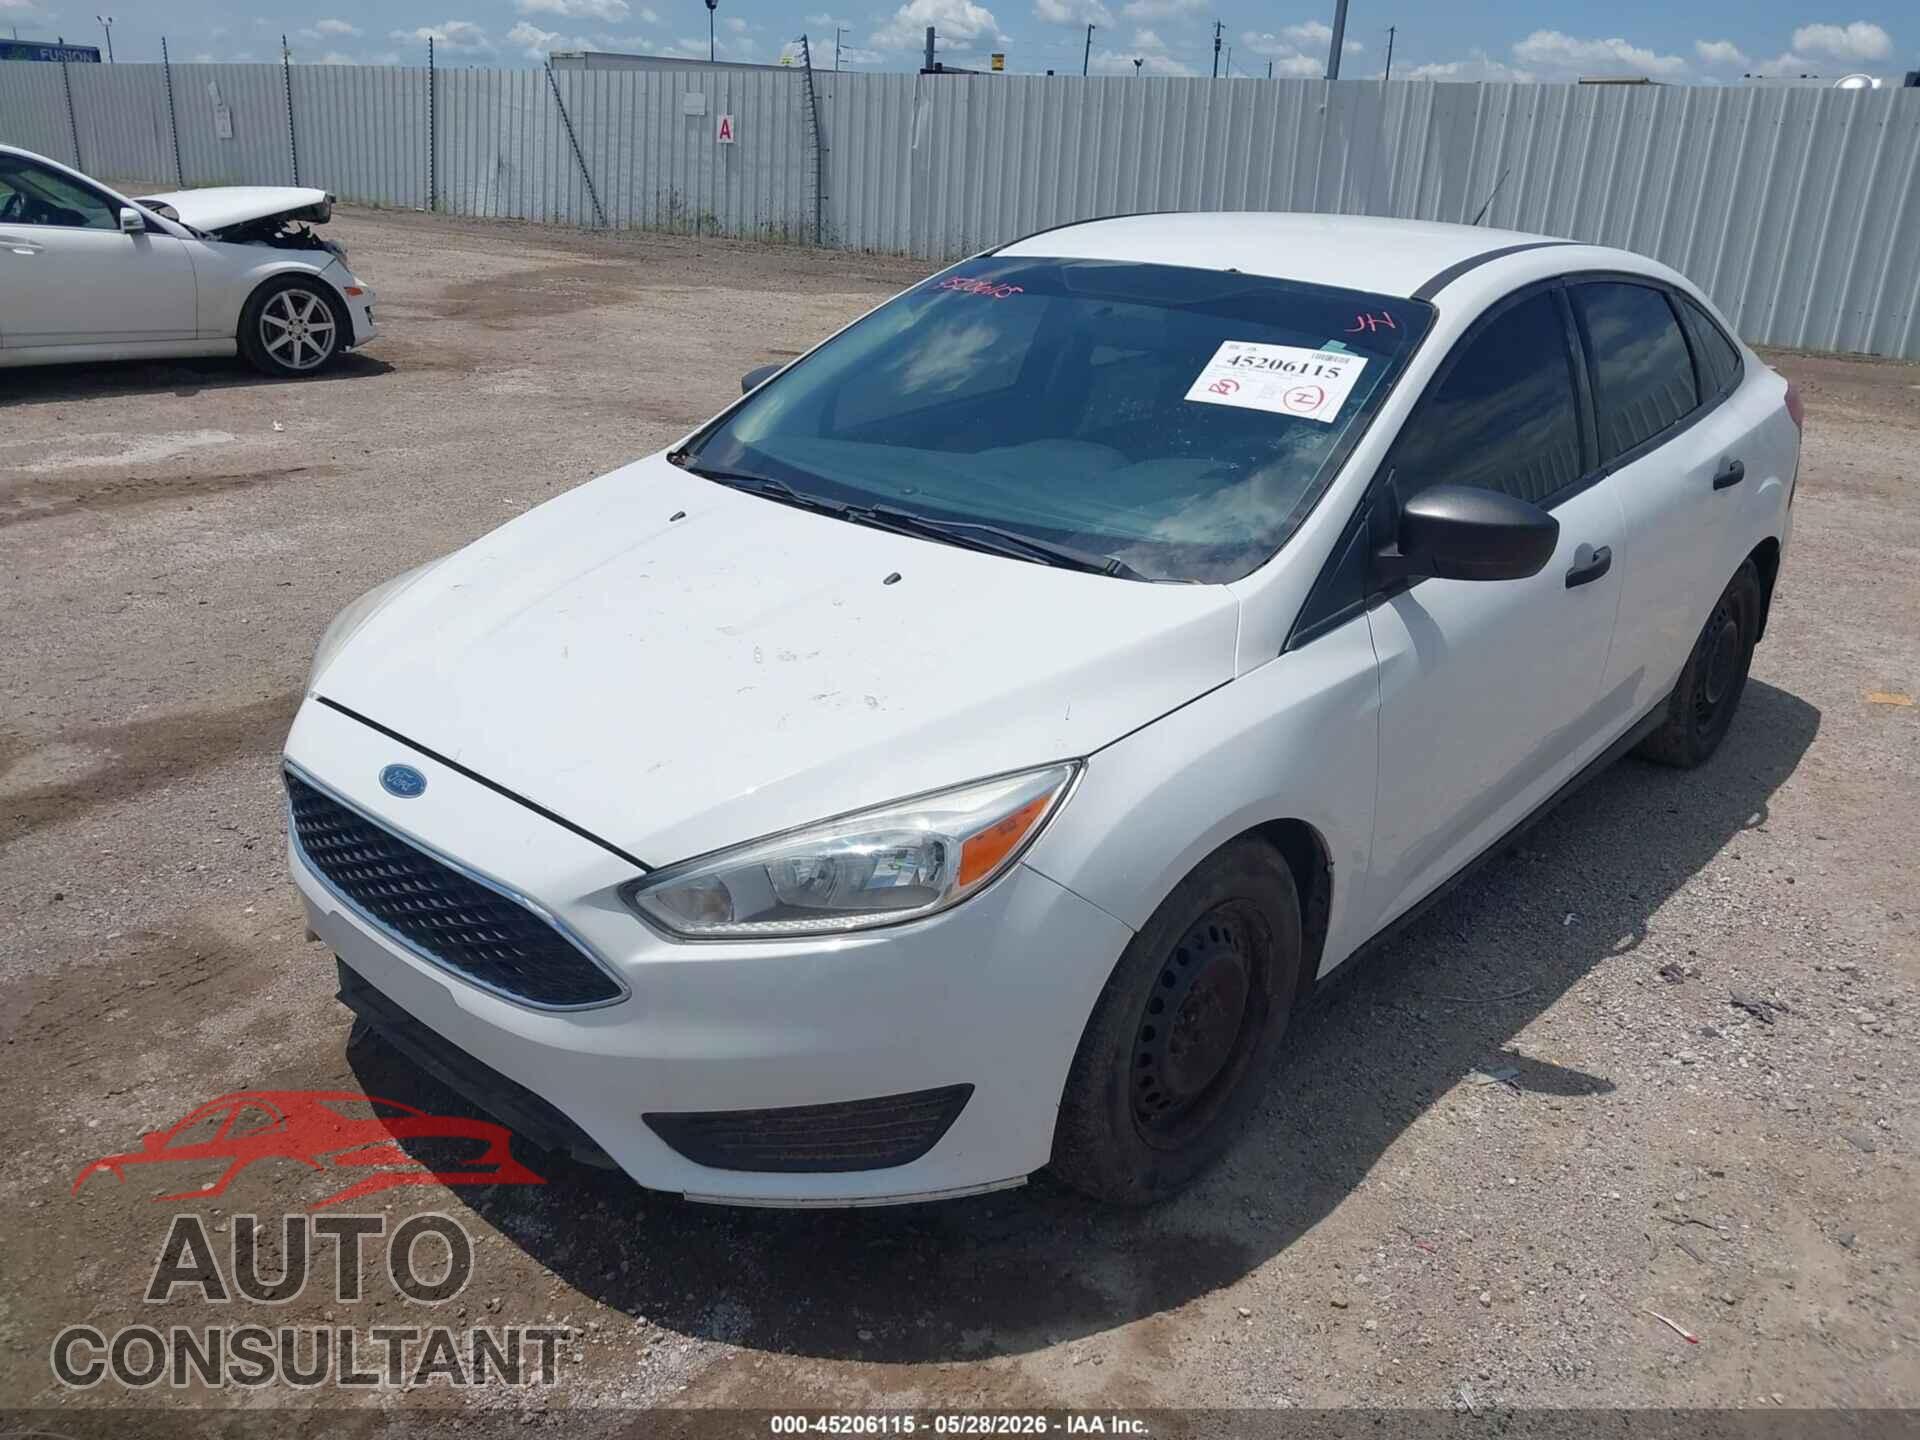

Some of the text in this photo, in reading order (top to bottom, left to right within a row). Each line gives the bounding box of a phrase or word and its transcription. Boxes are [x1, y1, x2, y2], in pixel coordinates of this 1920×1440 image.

[40, 48, 93, 63] FUSION
[719, 118, 731, 140] A
[1226, 354, 1342, 380] 45206115
